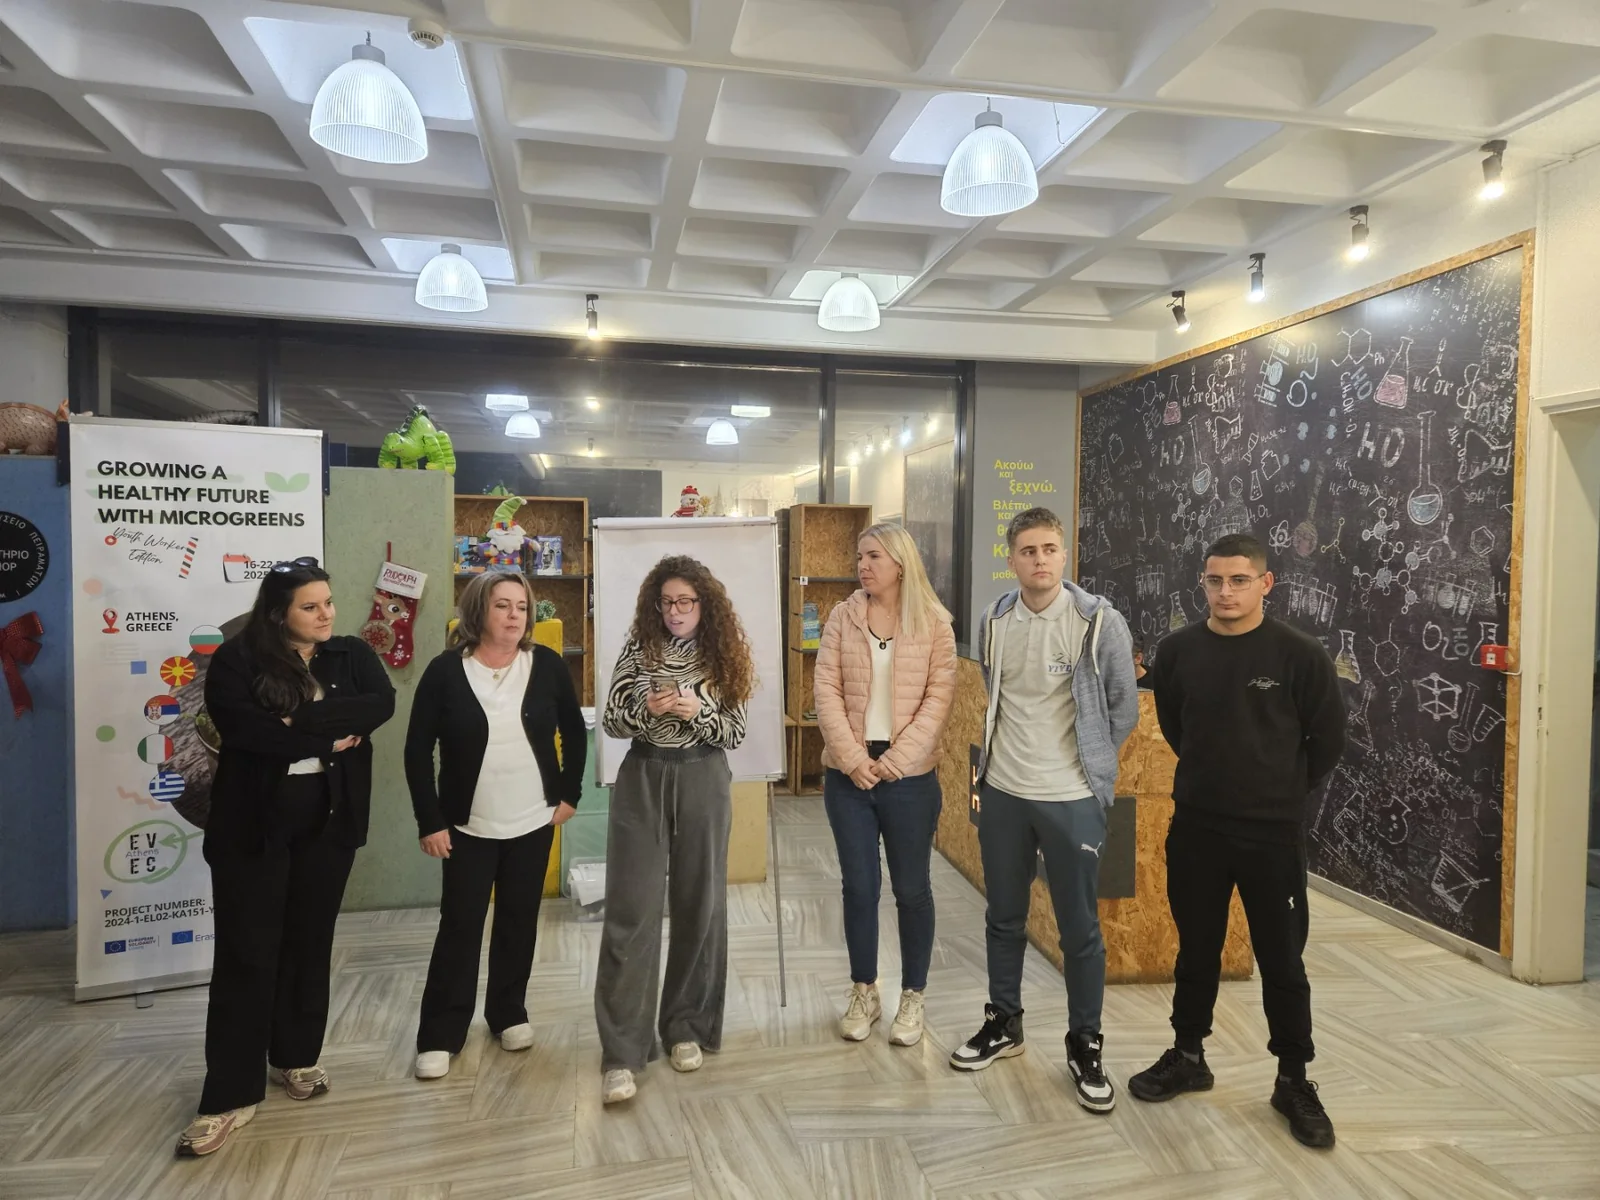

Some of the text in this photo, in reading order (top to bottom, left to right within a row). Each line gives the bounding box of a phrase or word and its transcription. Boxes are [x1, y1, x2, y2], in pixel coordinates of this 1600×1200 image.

[97, 460, 227, 480] GROWING A
[994, 459, 1034, 471] Ακούω
[999, 471, 1013, 479] και
[1009, 479, 1057, 496] ξεχνώ.
[98, 484, 270, 504] HEALTHY FUTURE
[993, 500, 1033, 511] Βλέπω
[97, 508, 305, 527] WITH MICROGREENS
[243, 560, 273, 569] 16-22
[125, 611, 179, 621] ATHENS,
[125, 622, 173, 632] GREECE
[125, 849, 159, 858] Athens
[104, 898, 206, 918] PROJECT NUMBER:
